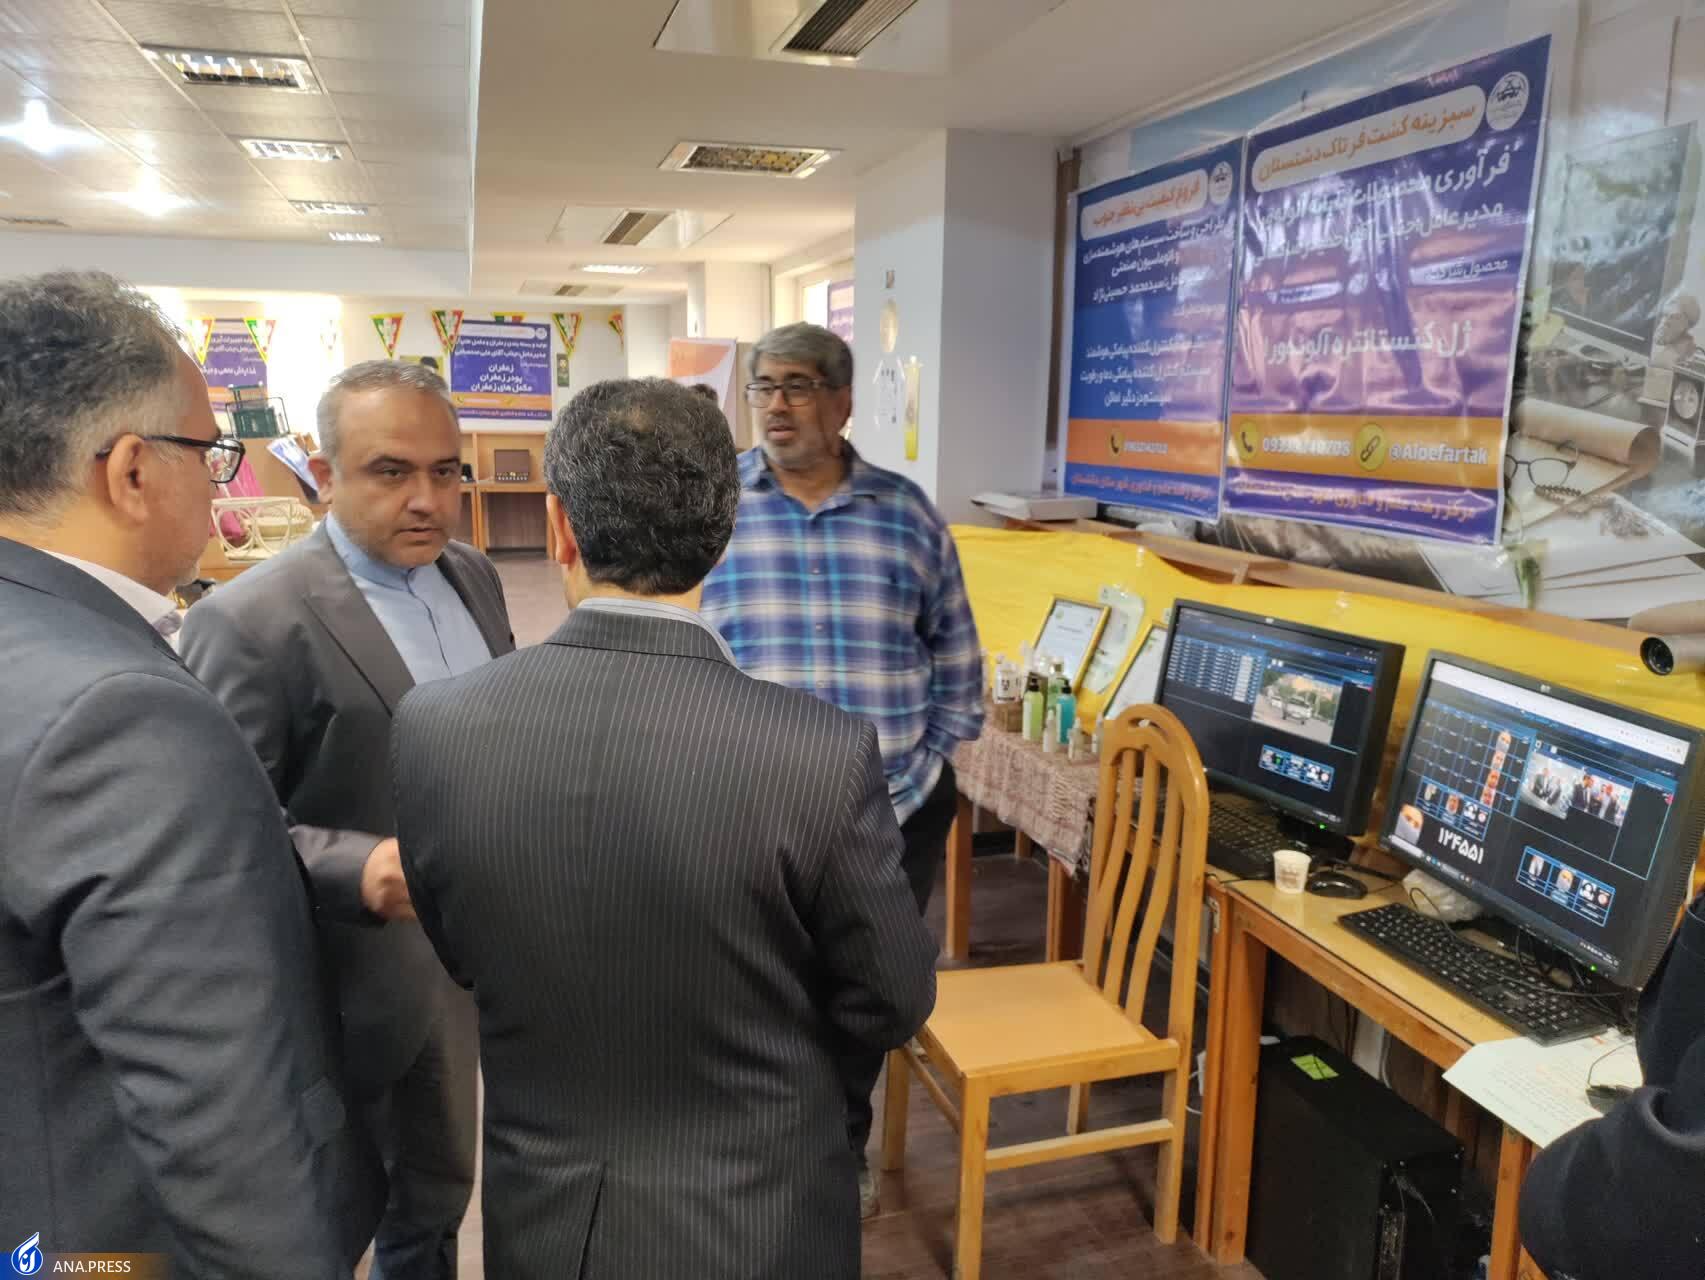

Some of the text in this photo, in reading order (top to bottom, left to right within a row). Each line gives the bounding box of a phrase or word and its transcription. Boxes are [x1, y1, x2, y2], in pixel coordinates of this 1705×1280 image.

[1411, 104, 1477, 134] سبزینه
[1367, 114, 1409, 145] کشت
[1462, 258, 1509, 280] محصول
[488, 363, 514, 373] زعفران
[479, 373, 523, 384] پودر زعفران
[470, 382, 497, 392] زعفران
